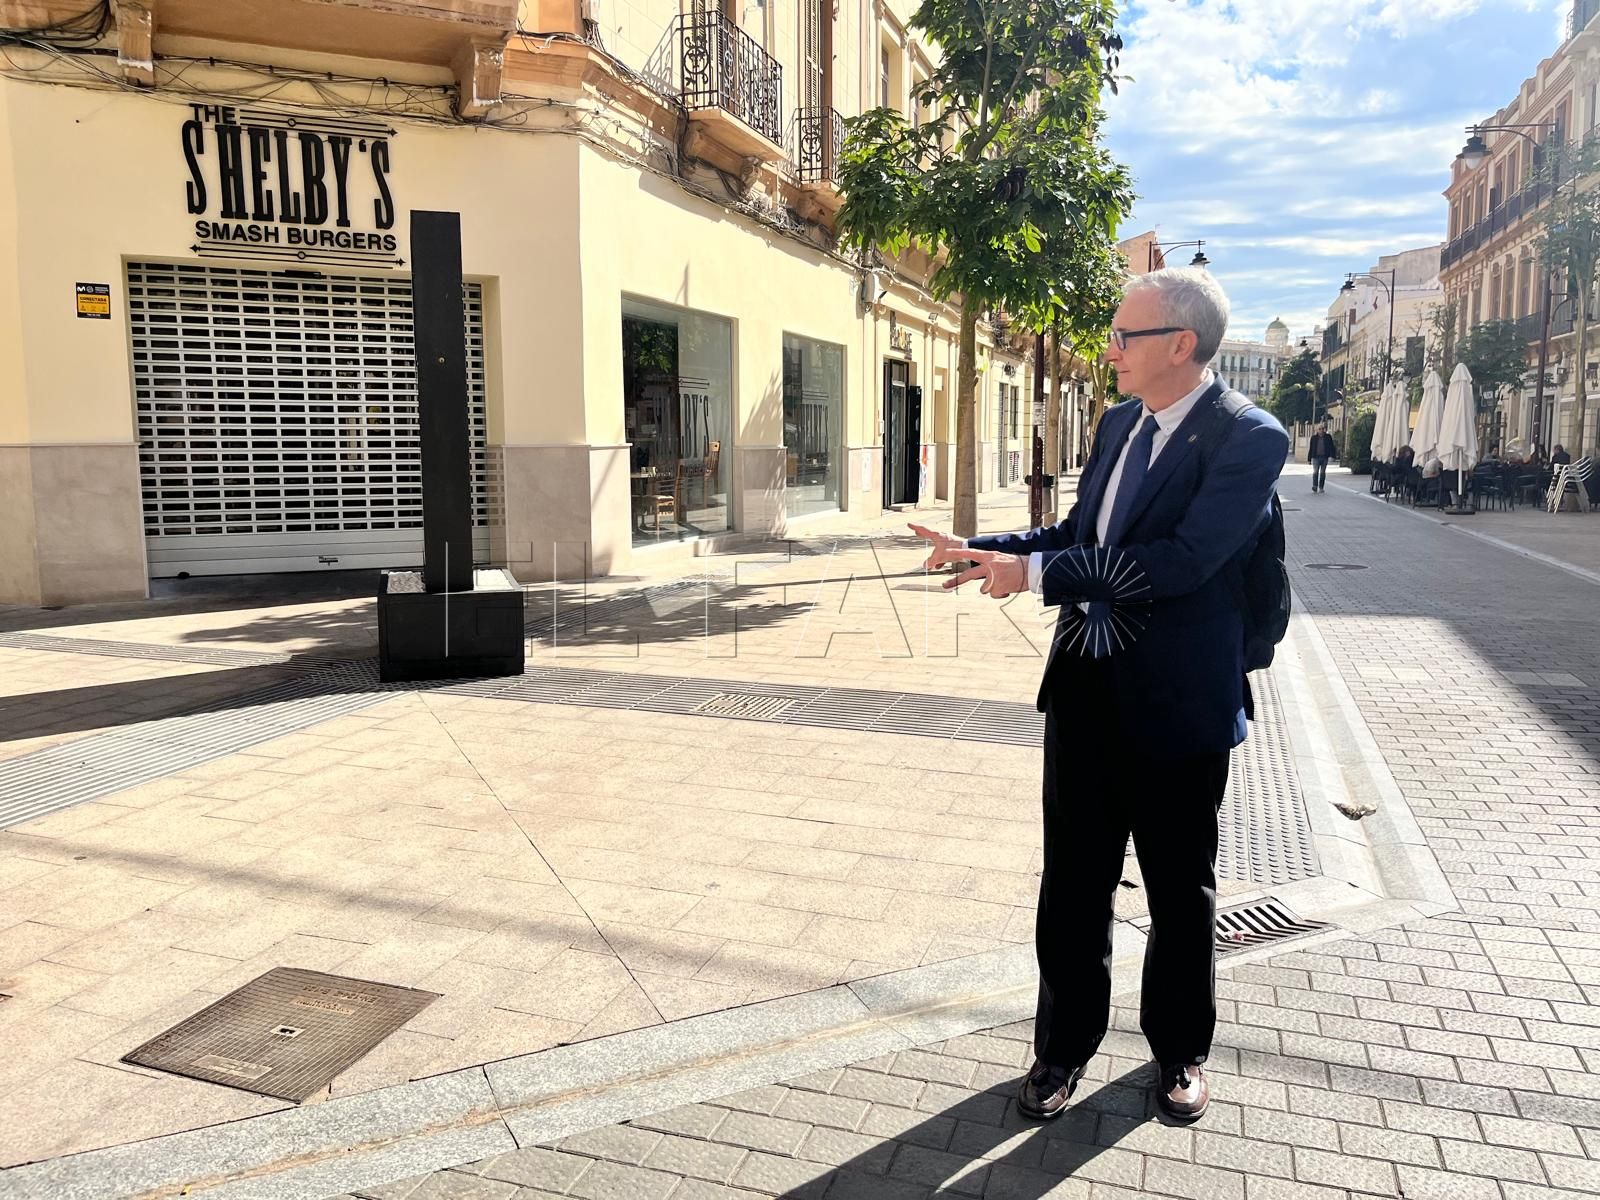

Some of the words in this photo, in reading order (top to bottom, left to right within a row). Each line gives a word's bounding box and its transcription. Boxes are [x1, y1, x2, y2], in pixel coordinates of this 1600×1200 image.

[189, 103, 237, 125] THE
[182, 120, 395, 230] SHELBY'S
[195, 221, 279, 243] SMASH
[287, 227, 397, 251] BURGERS
